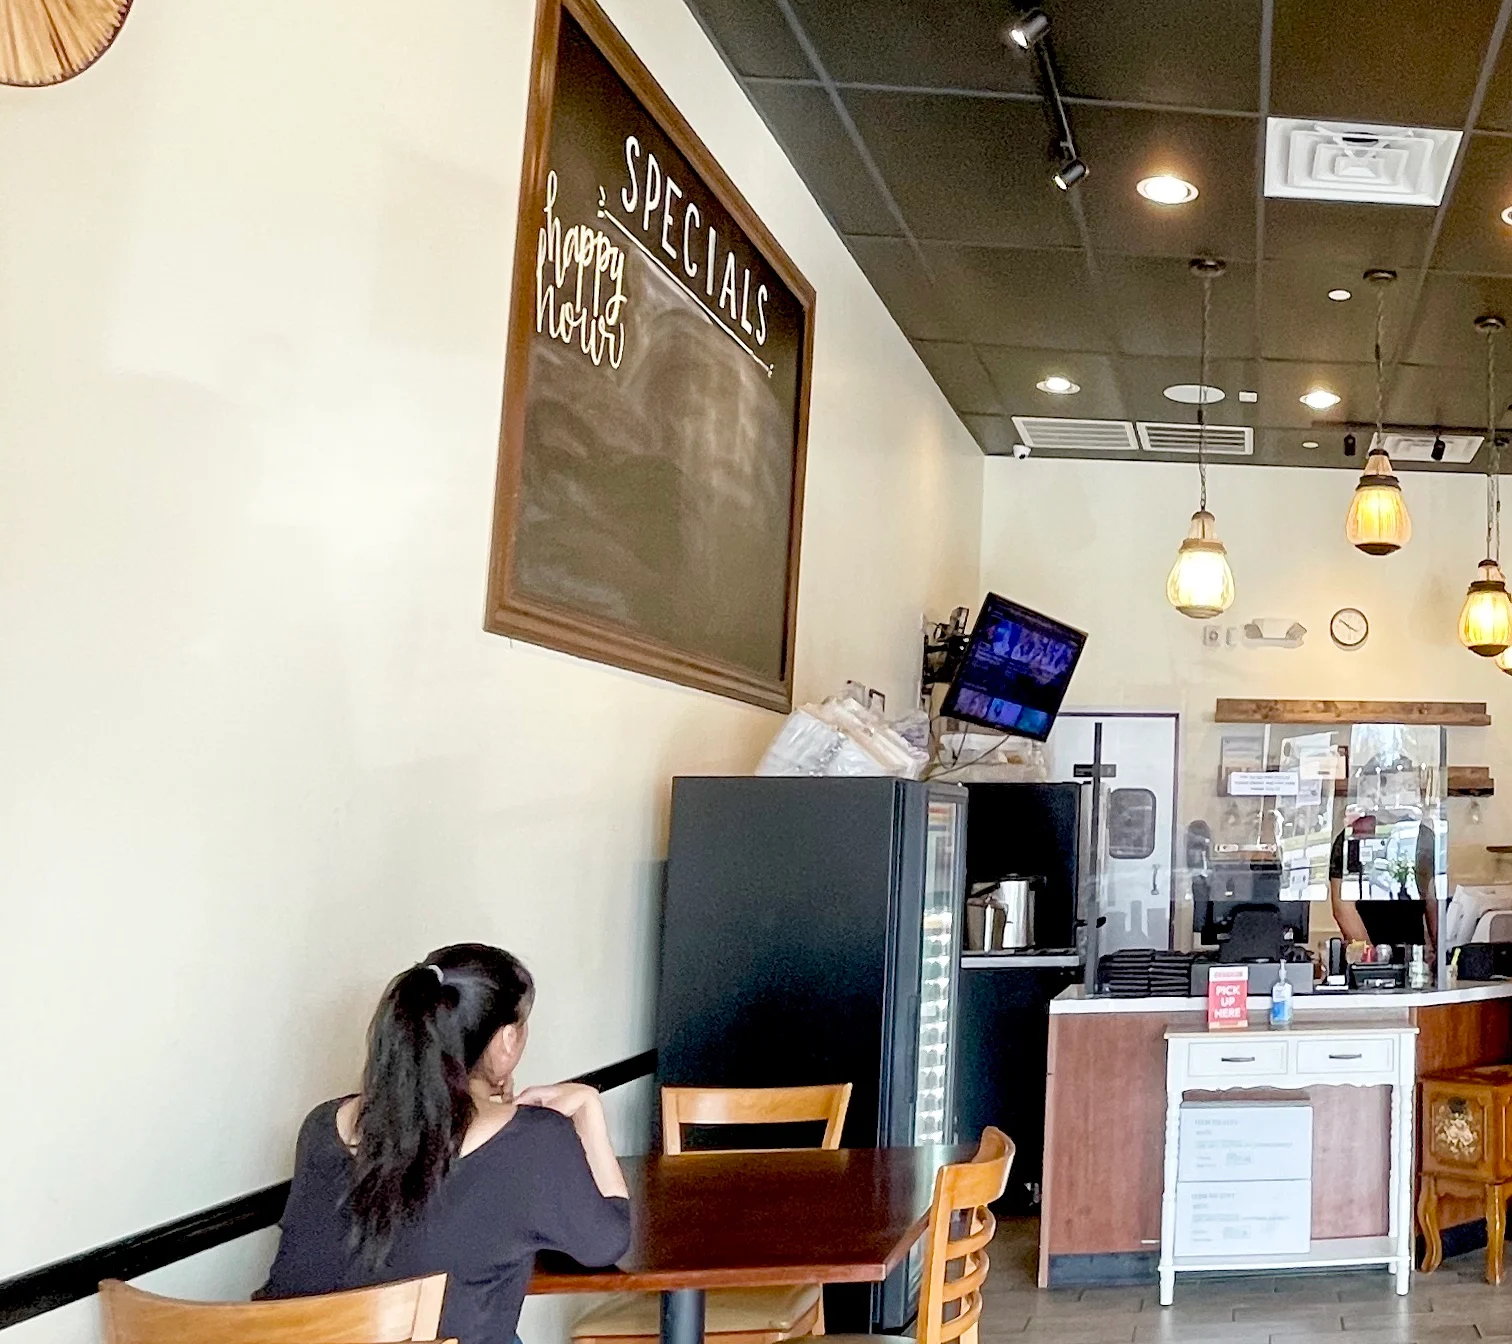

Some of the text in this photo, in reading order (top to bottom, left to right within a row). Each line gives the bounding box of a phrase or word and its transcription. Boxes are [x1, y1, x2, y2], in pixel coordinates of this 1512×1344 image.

[543, 170, 628, 325] happy
[621, 135, 768, 346] SPECIALS
[536, 228, 625, 370] hour
[1214, 1007, 1241, 1019] HERE
[1215, 985, 1241, 996] PICK
[1220, 996, 1236, 1007] UP
